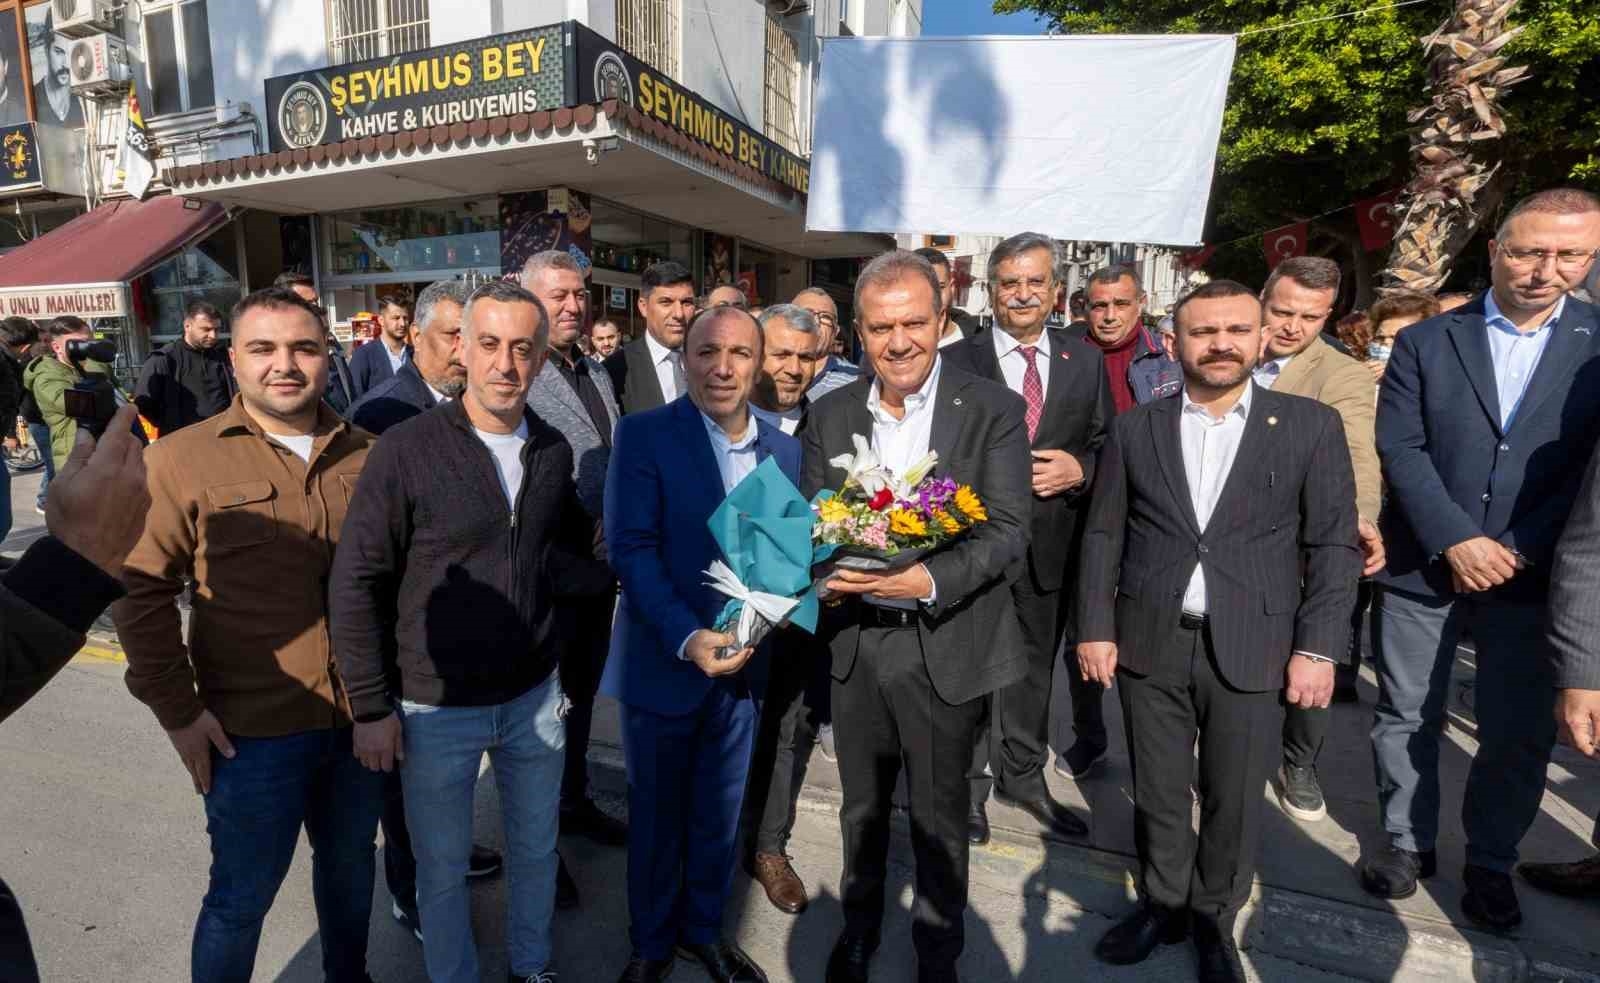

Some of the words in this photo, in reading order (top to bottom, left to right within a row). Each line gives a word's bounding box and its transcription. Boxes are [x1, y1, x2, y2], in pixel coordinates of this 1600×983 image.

[331, 52, 472, 115] ŞEYHMUS
[481, 38, 545, 82] BEY
[341, 111, 398, 138] KAHVE
[403, 108, 417, 130] &
[738, 129, 766, 172] BEY
[10, 296, 40, 315] UNLU
[46, 289, 116, 314] MAMÜLLERİ
